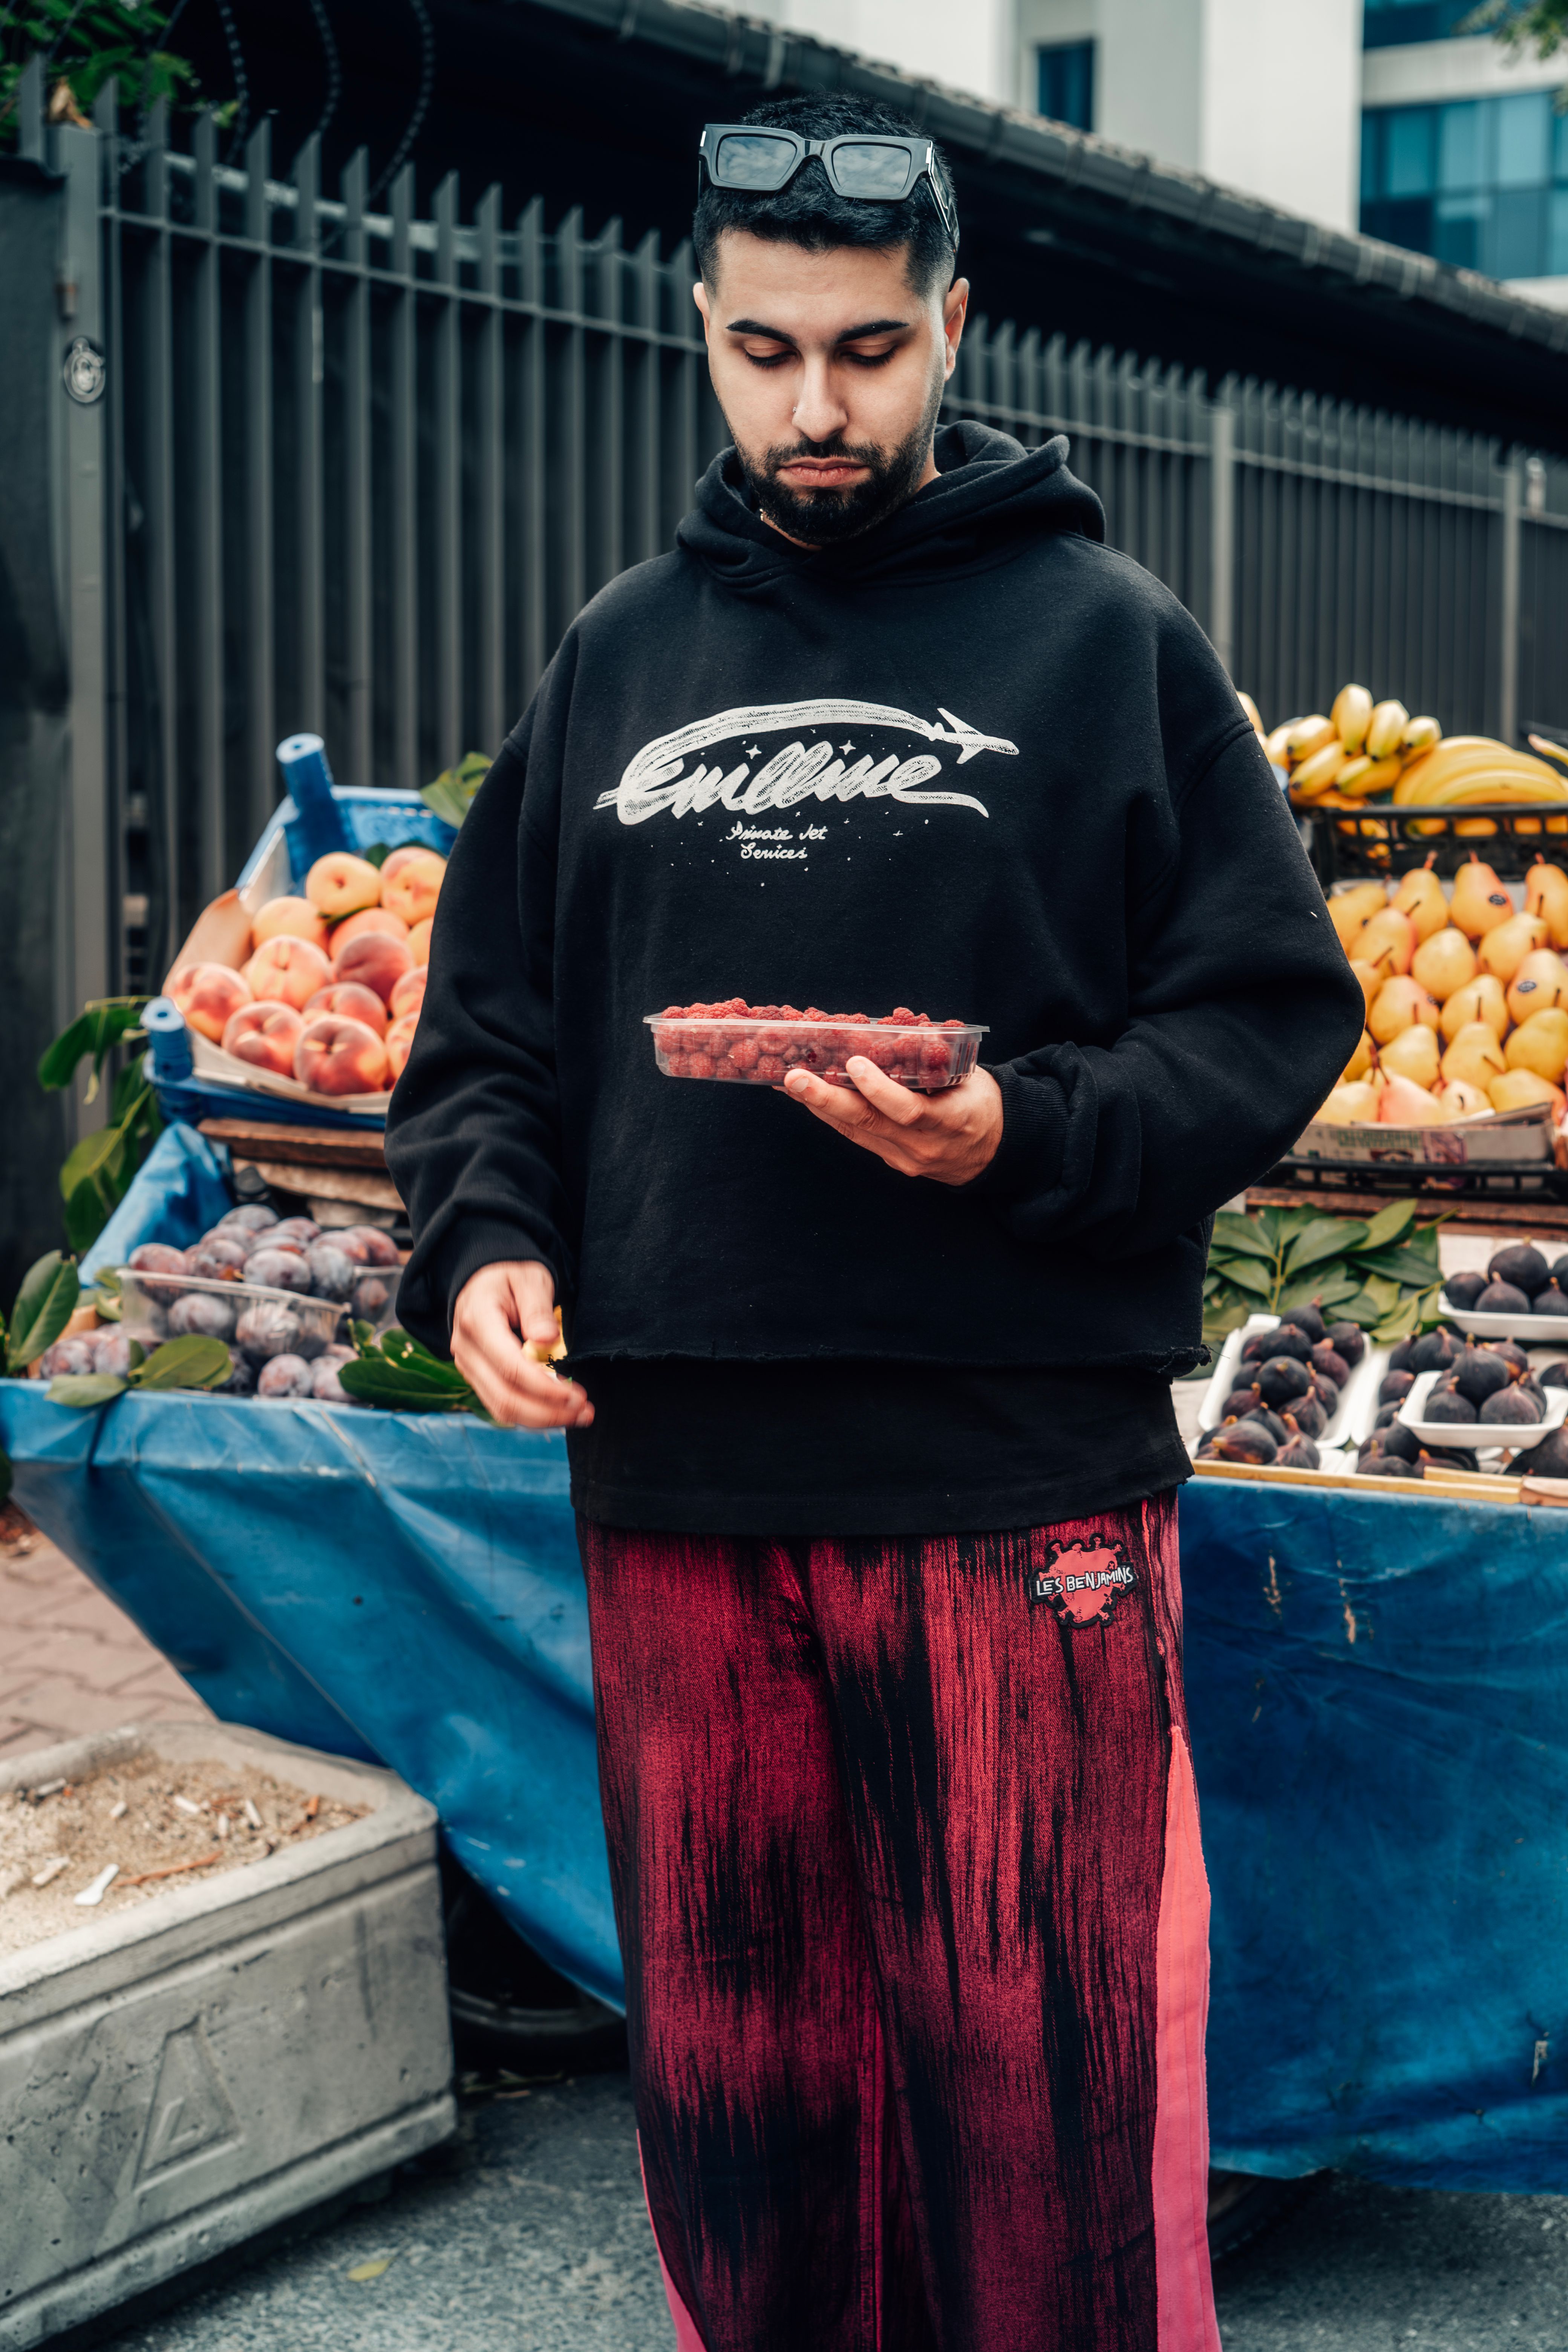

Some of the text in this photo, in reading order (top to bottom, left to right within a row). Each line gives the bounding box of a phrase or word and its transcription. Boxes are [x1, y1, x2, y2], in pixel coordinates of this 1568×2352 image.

[725, 821, 828, 841] Private Jet
[740, 842, 808, 859] Services
[1036, 1566, 1133, 1596] LES BENJAMINS
